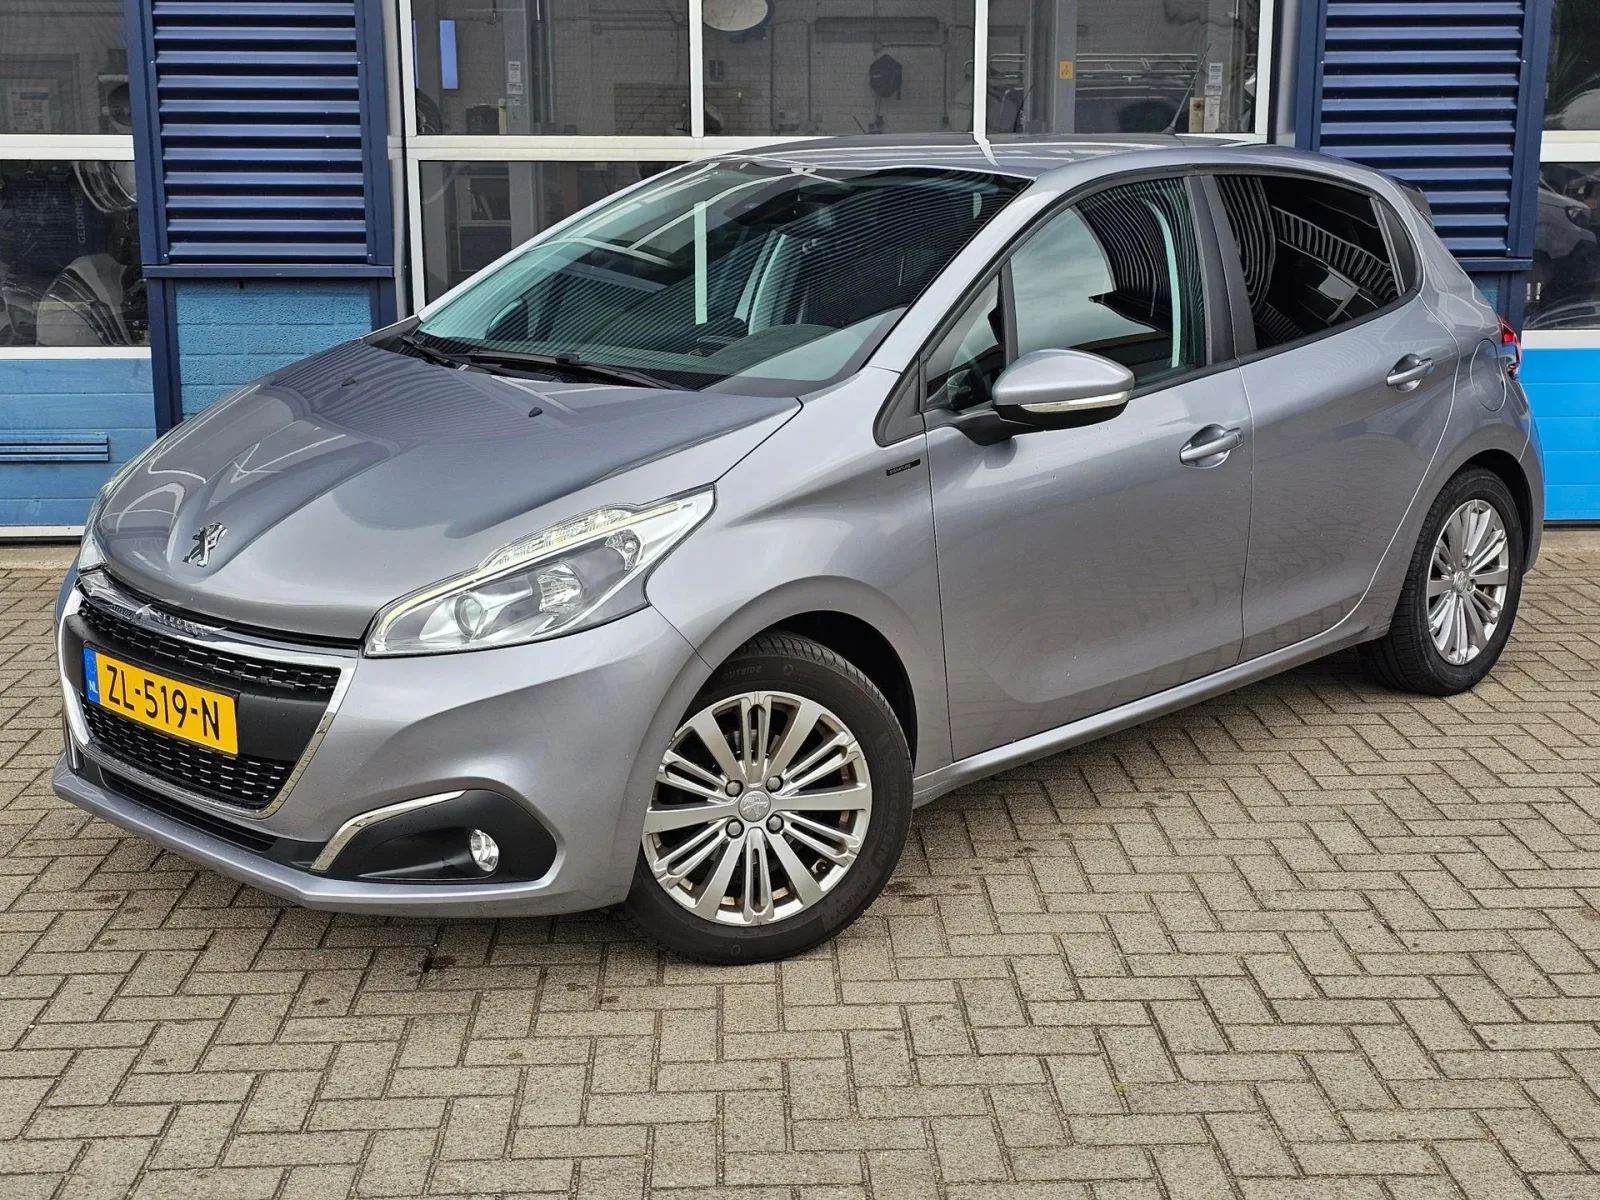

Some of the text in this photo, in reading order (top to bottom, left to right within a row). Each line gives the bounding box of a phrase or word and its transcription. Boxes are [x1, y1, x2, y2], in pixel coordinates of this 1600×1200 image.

[74, 199, 86, 244] GEDORE
[88, 681, 98, 693] NL
[106, 664, 220, 741] ZL-519-N
